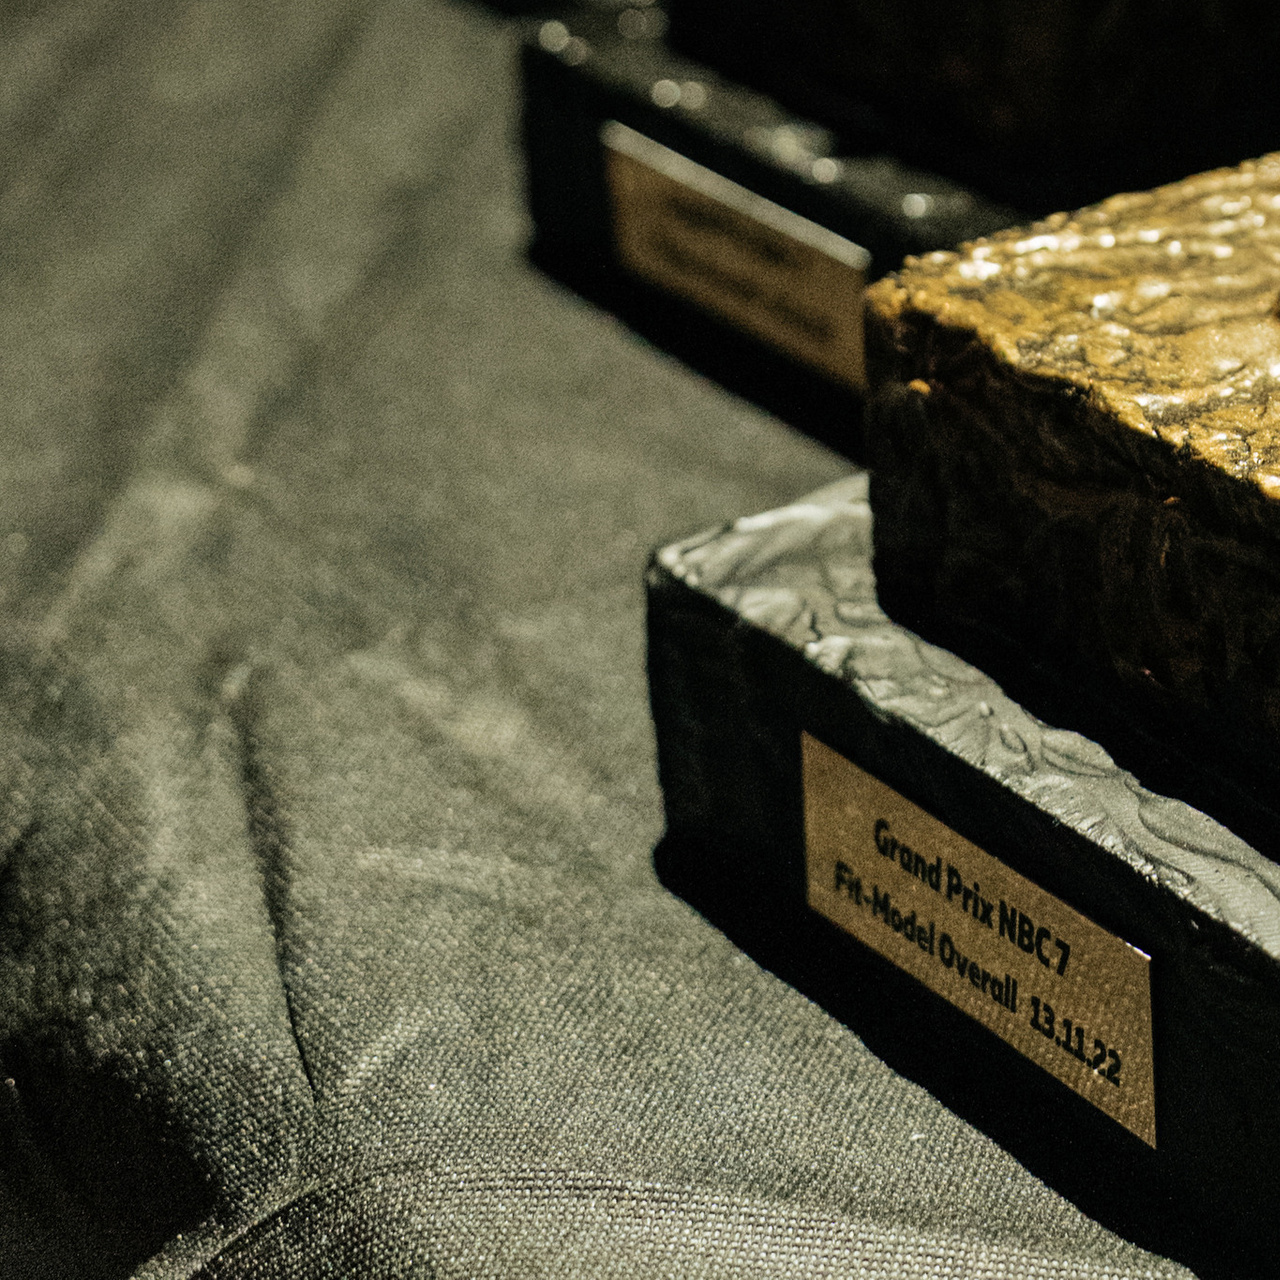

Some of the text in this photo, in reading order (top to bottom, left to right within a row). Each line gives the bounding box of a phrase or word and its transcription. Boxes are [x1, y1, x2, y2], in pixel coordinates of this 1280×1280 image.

[874, 818, 942, 891] Grand
[947, 863, 994, 930] Prix
[834, 860, 1121, 1088] Fit-Model Overall 13.11.22
